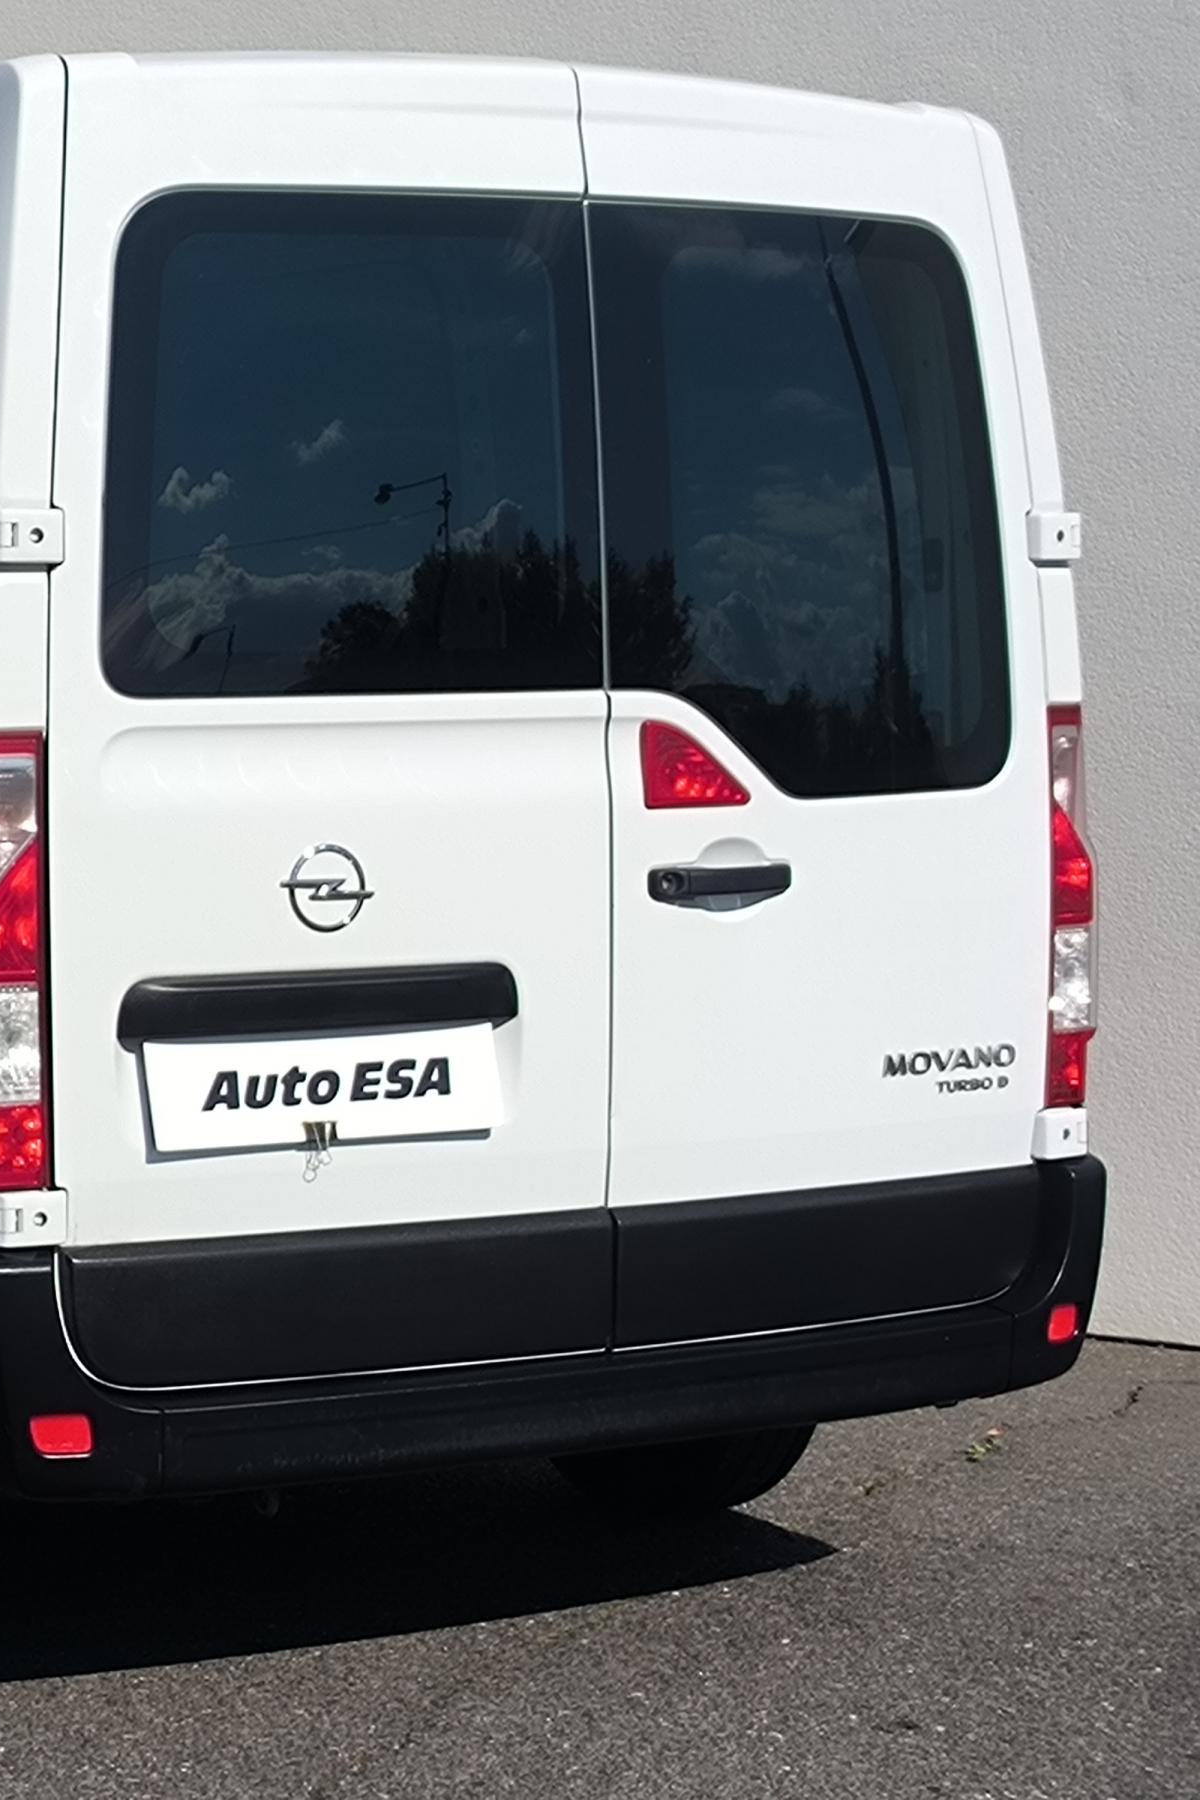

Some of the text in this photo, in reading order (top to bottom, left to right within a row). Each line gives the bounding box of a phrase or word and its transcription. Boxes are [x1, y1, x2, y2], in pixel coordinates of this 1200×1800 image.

[882, 1043, 1016, 1077] MOVANO
[202, 1057, 451, 1111] Auto ESA
[936, 1076, 1009, 1093] TURBO D
